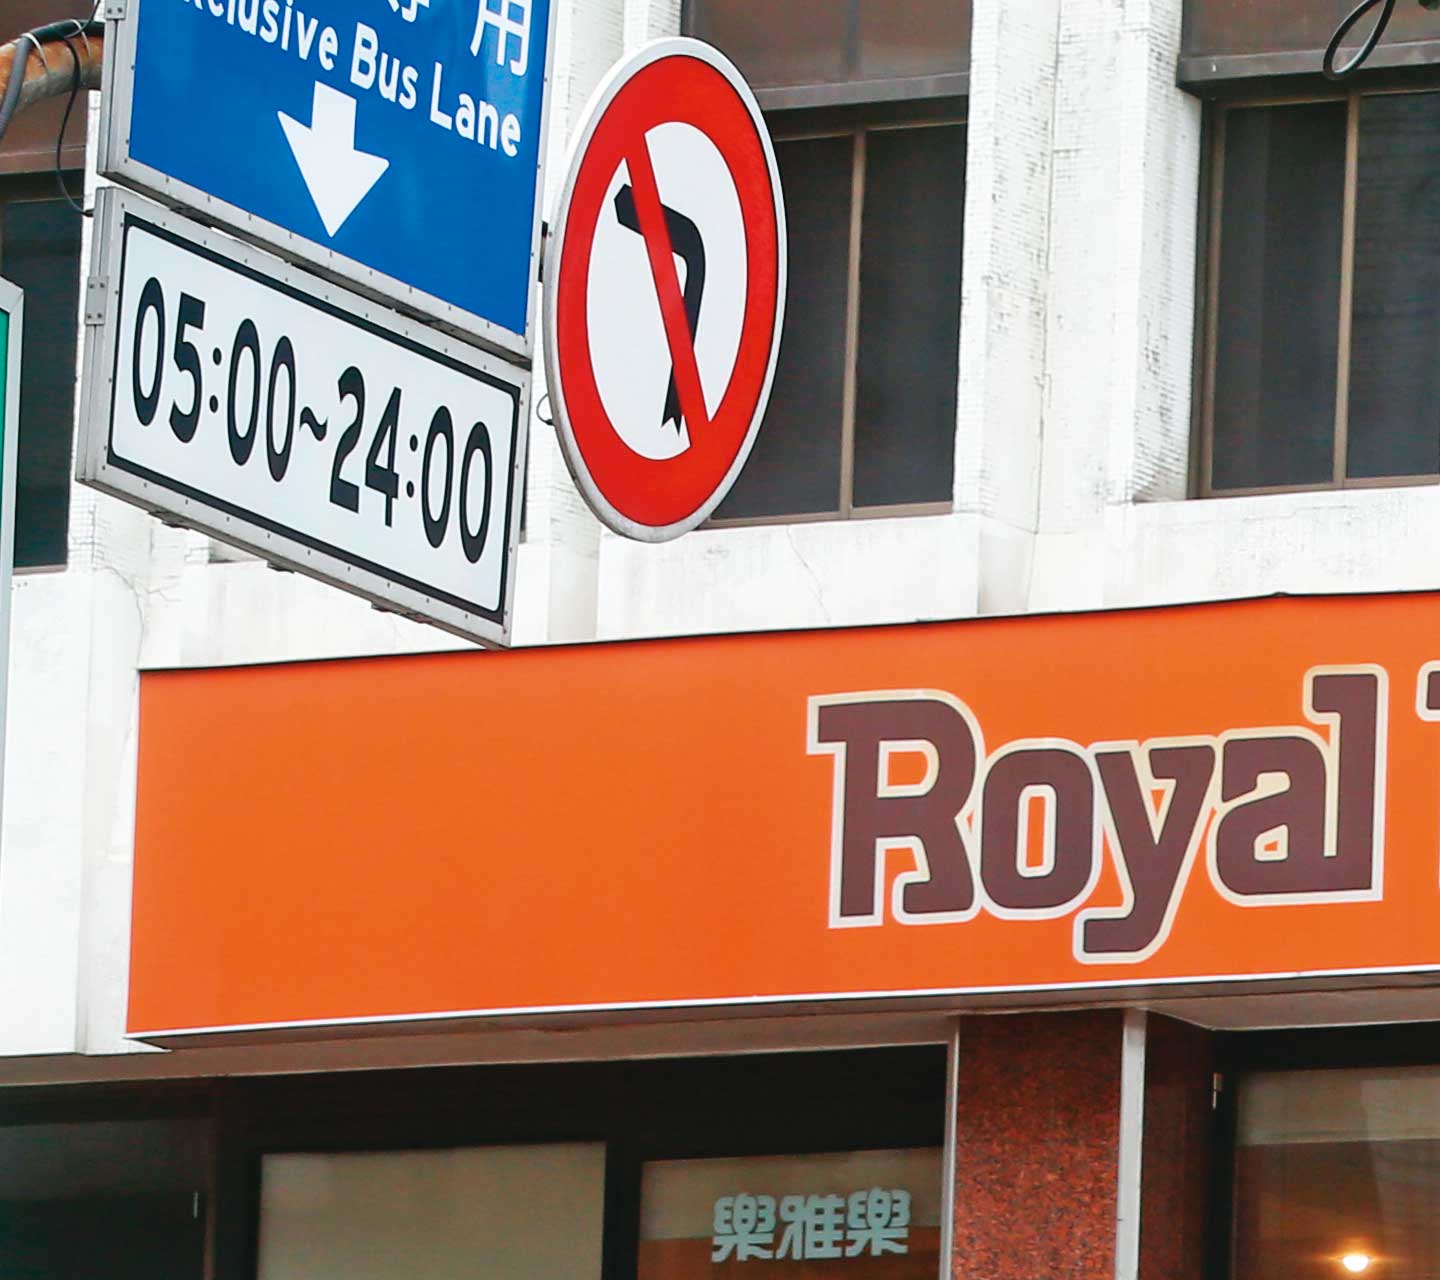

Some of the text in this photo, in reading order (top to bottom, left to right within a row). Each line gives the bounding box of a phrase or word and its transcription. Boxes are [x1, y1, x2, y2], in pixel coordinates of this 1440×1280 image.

[350, 22, 419, 110] Bus
[430, 62, 521, 158] Lane
[132, 276, 492, 565] 05:00~24:00
[807, 664, 1388, 965] Royal
[711, 1188, 911, 1263] 樂雅樂
